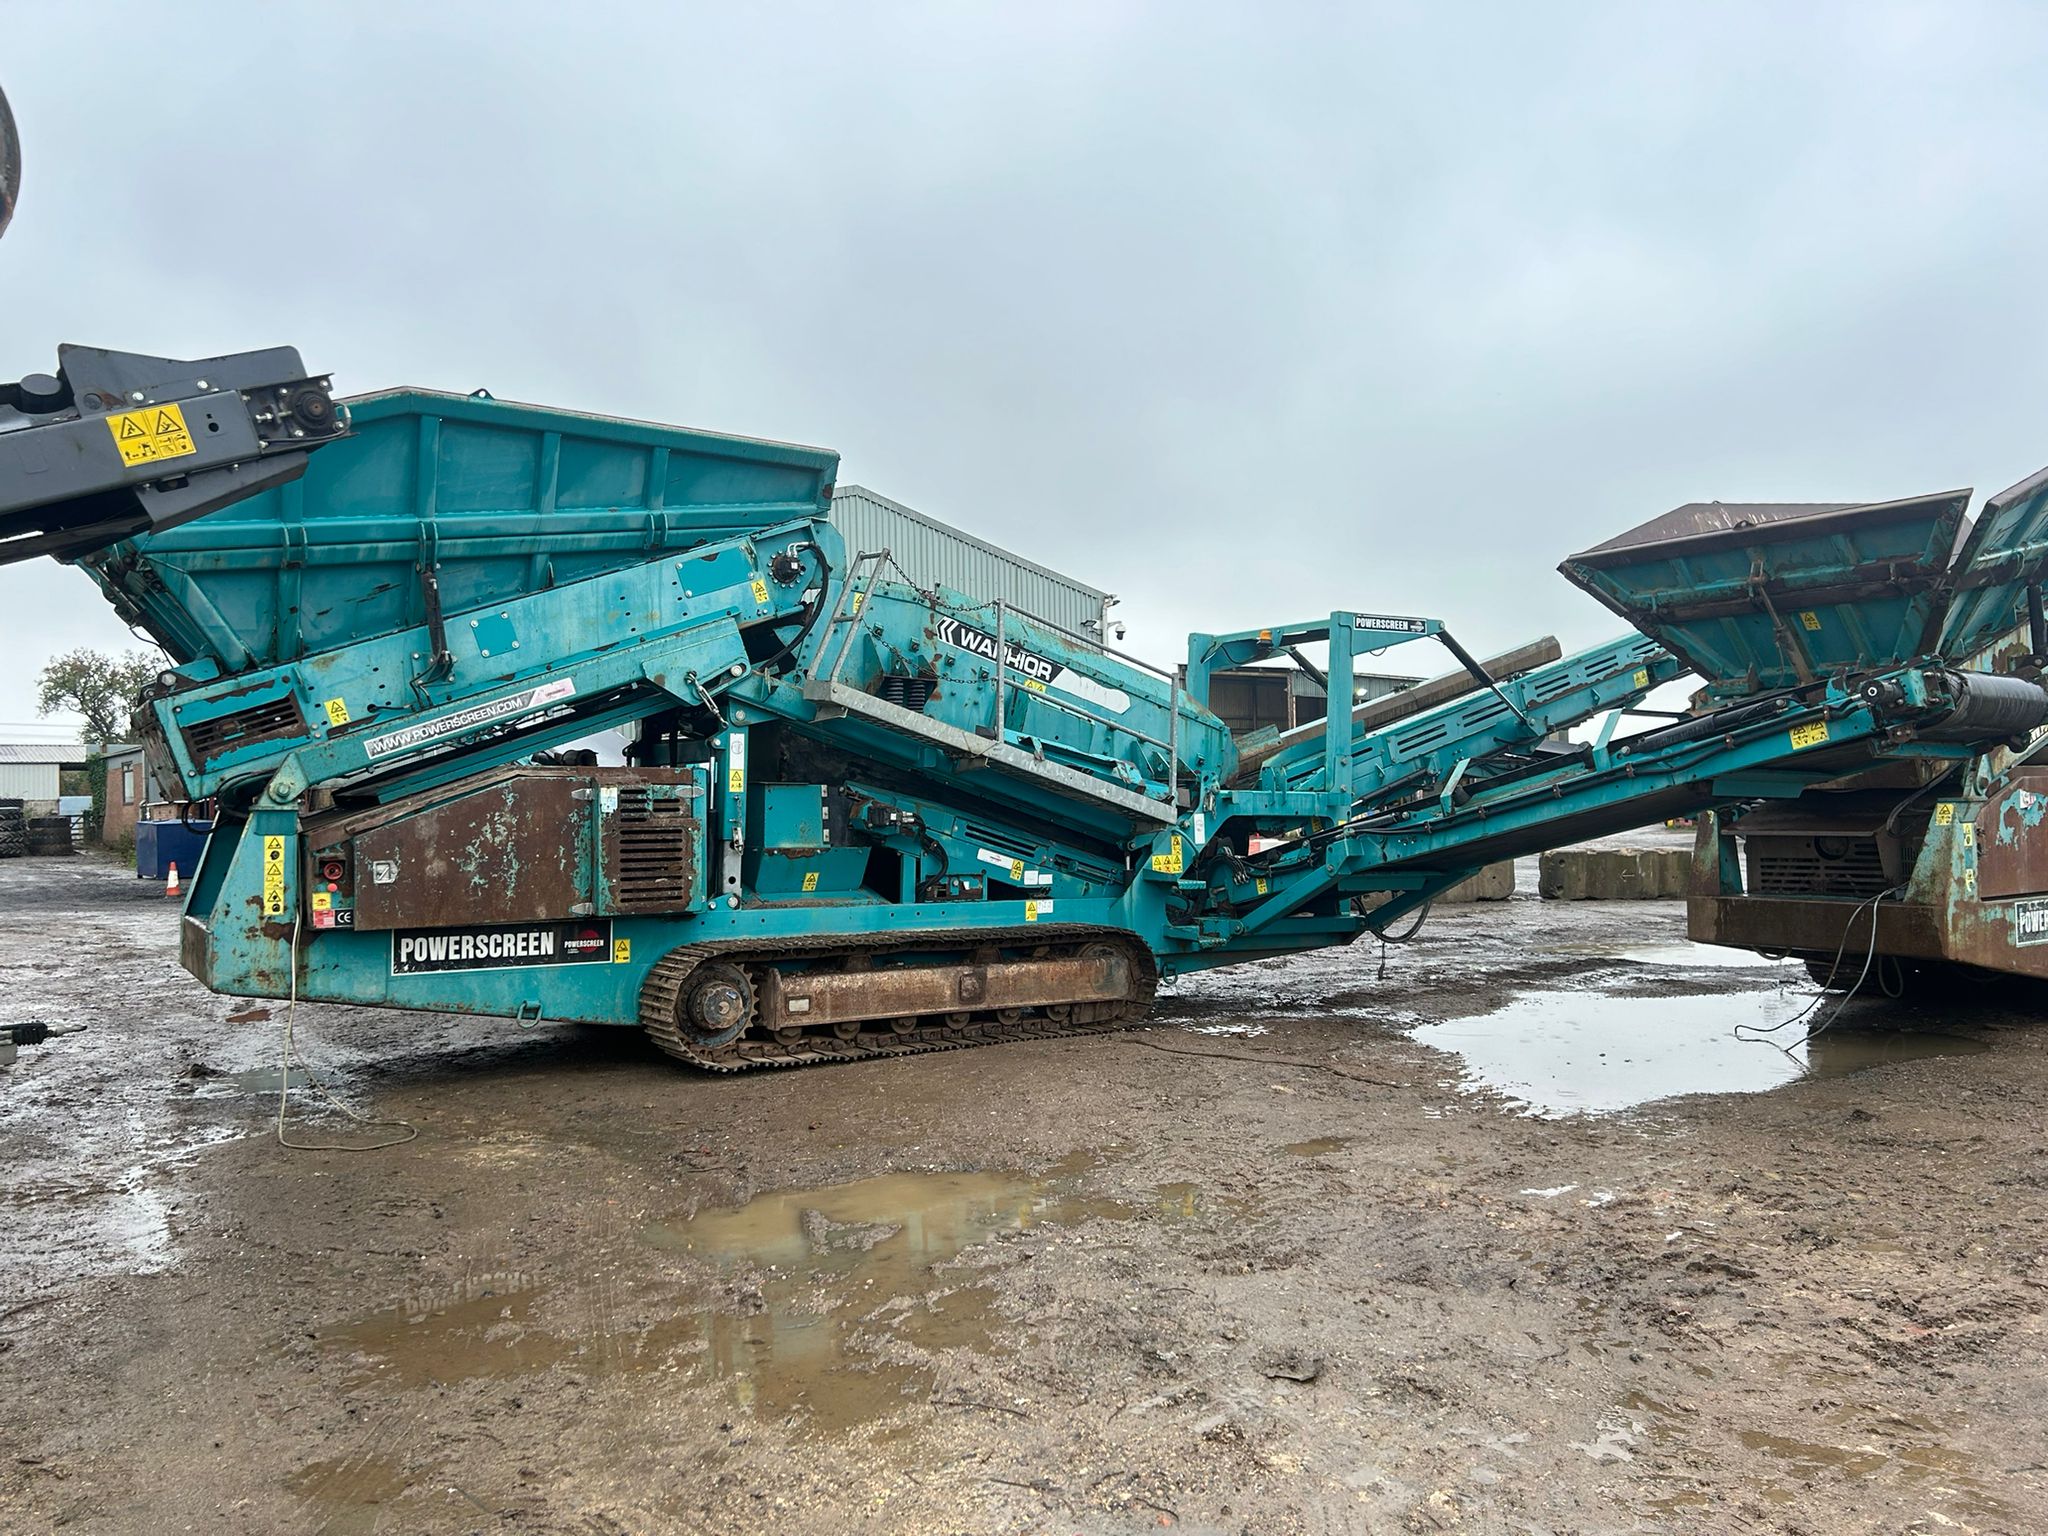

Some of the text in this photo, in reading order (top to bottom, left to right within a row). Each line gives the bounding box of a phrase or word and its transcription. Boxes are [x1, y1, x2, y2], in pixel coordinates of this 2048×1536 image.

[1355, 617, 1409, 631] POWERSCREEN
[373, 697, 525, 753] WWW.POWERSCREEN.COM
[337, 912, 351, 923] CE
[400, 931, 554, 963] POWERSCREEN
[564, 939, 605, 949] POWERSCREEN
